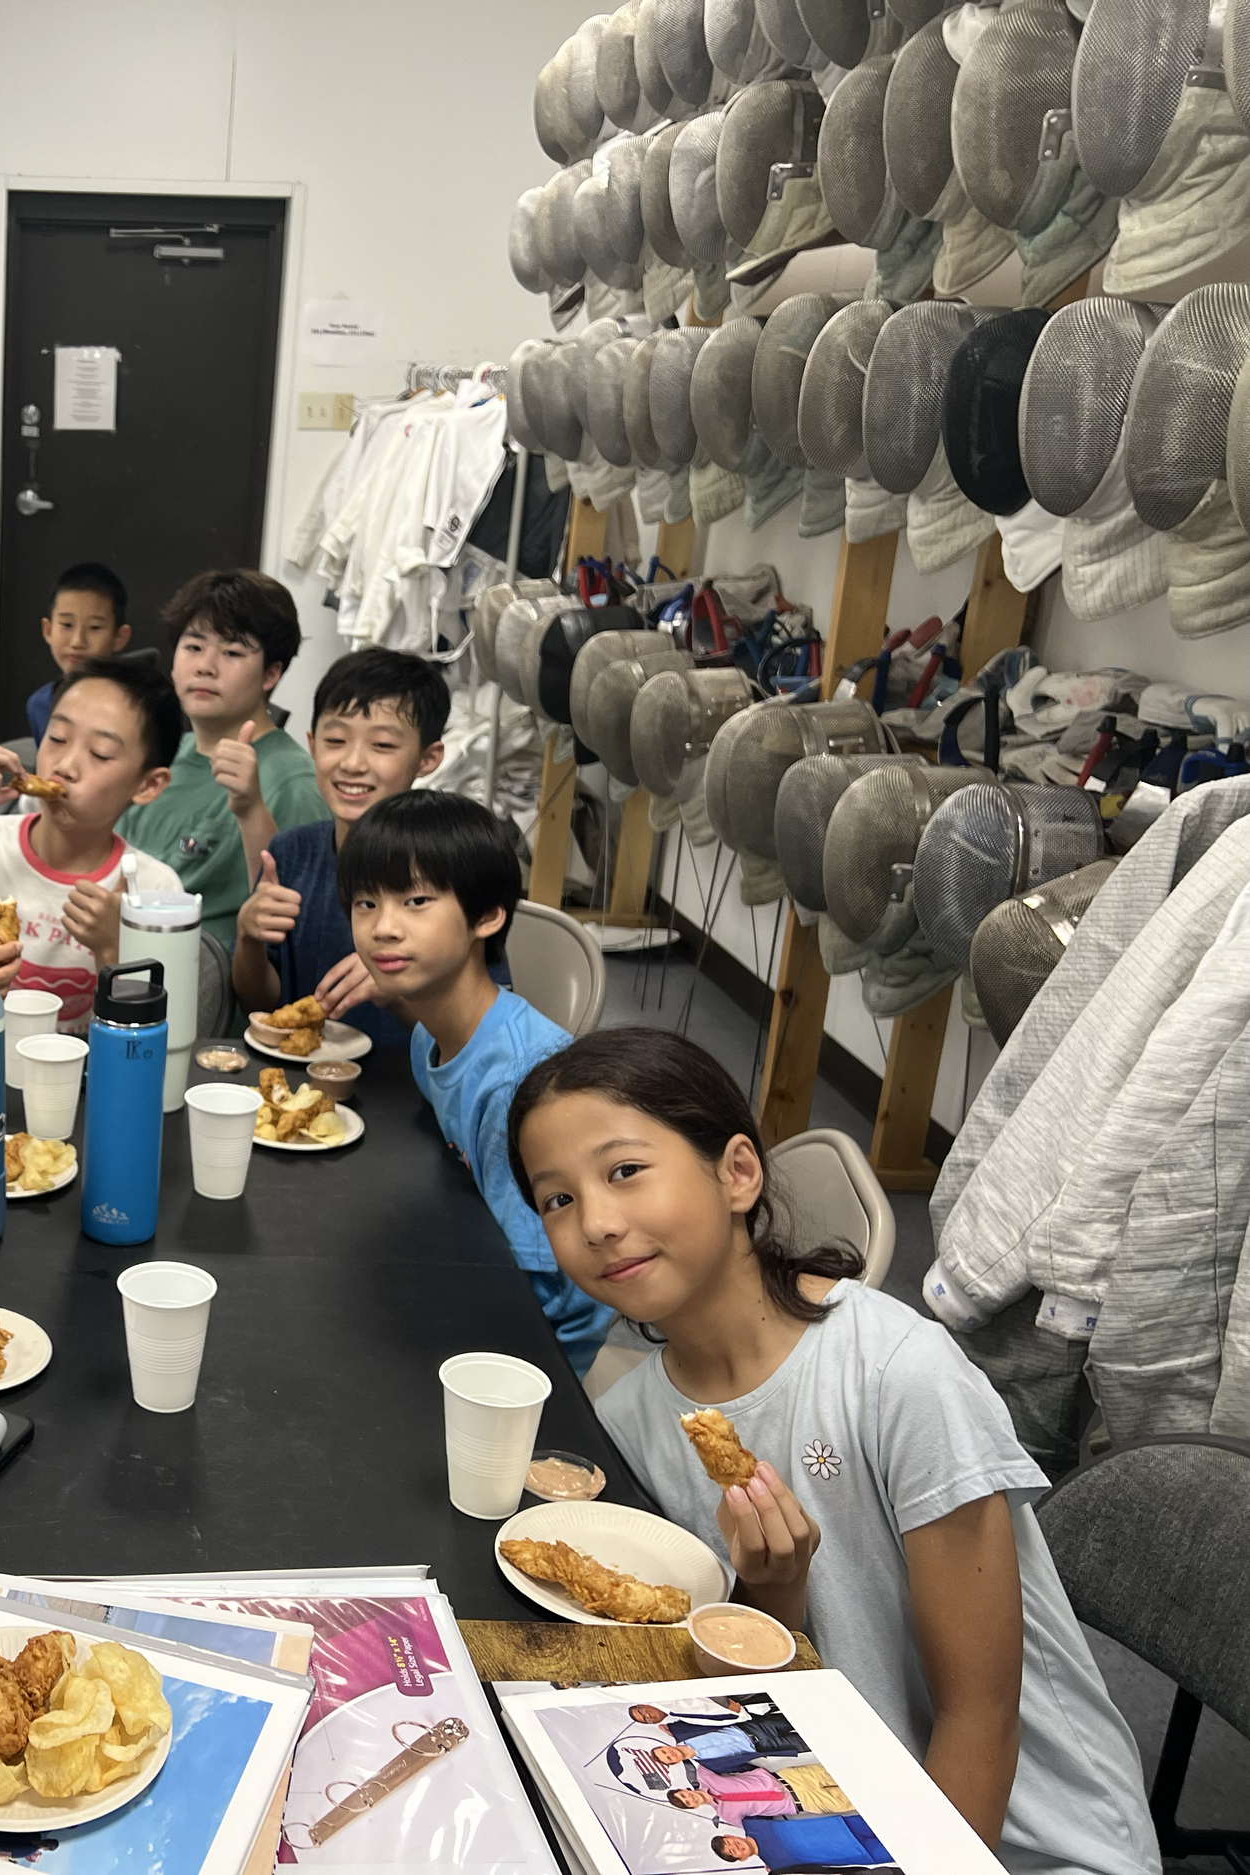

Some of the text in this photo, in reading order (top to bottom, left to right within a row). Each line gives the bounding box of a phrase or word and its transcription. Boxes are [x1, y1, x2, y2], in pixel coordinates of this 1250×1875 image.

[399, 1668, 412, 1687] Holds
[401, 1636, 425, 1687] Legal Size Paper
